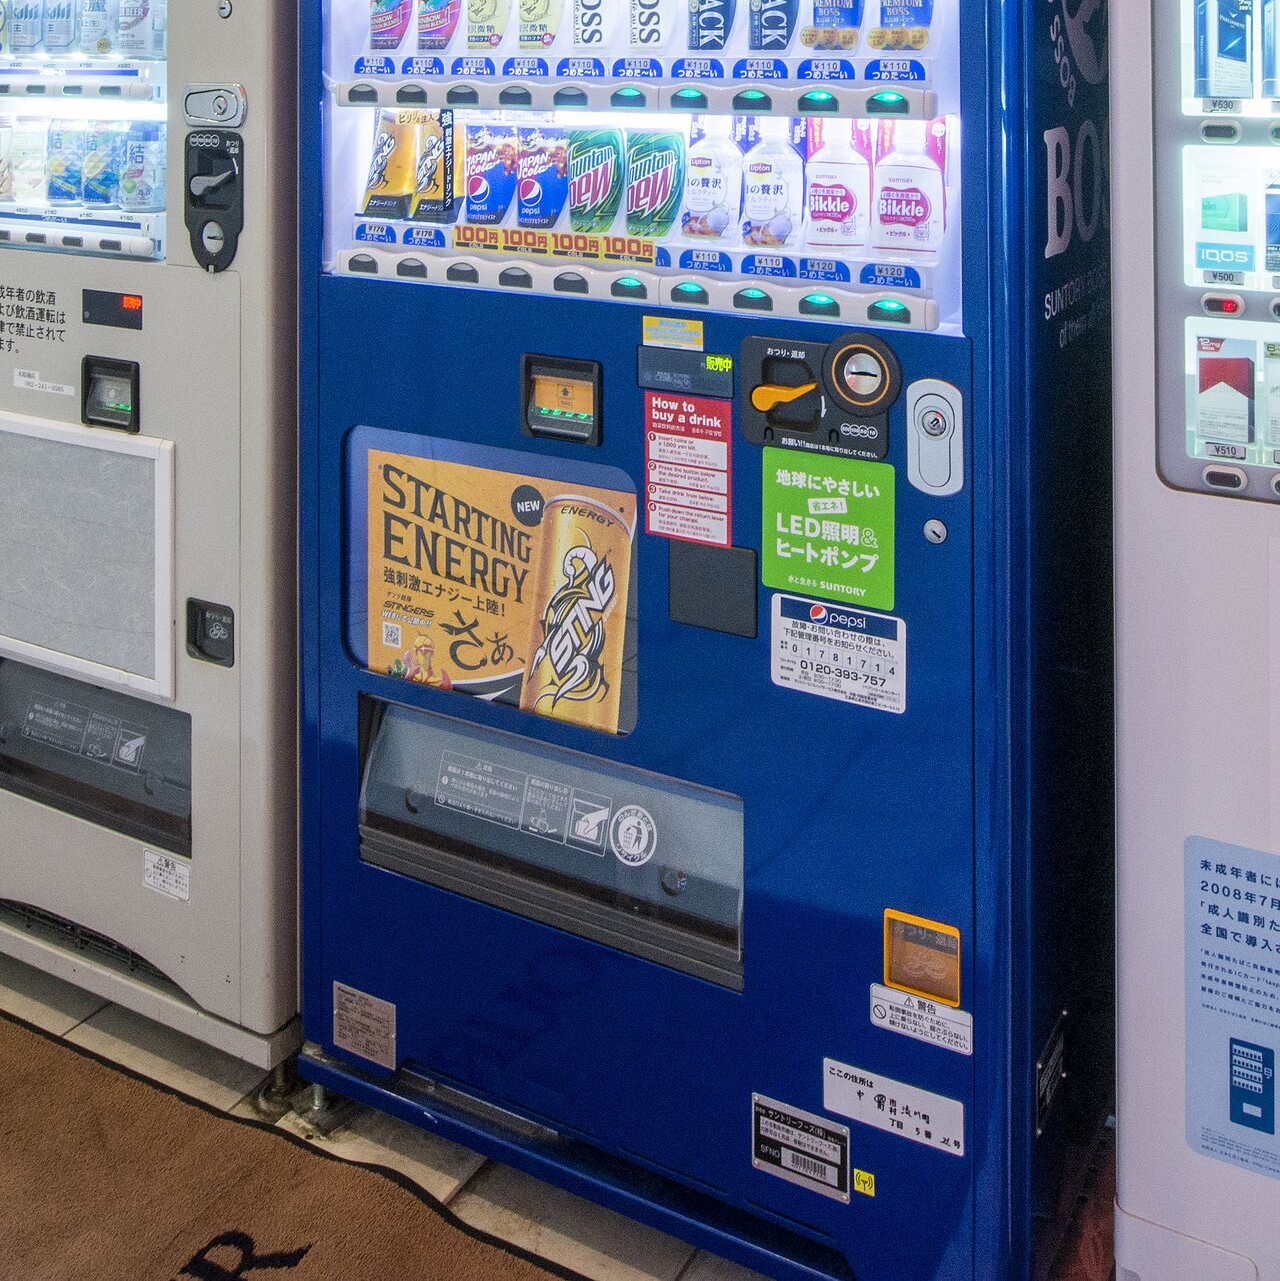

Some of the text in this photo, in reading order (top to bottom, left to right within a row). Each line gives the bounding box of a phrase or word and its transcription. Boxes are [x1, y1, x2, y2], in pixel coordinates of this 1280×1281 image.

[879, 198, 925, 218] Bikkle
[1200, 248, 1250, 265] IQOS
[706, 355, 733, 372] 販売中
[651, 396, 696, 413] How to
[651, 409, 722, 428] buy a drink
[1214, 444, 1238, 457] ¥510
[775, 468, 881, 499] 地球にやさしい
[382, 462, 532, 564] STARTING
[516, 500, 541, 514] NEW
[560, 505, 615, 528] ENERGY
[382, 510, 531, 605] ENERGY
[776, 537, 879, 573] ヒートポンプ
[383, 565, 507, 618] 強刺激エナジー上陸!
[820, 581, 867, 597] SUNTORY
[829, 612, 867, 629] pepsi
[800, 660, 886, 687] 0120-393-757
[916, 999, 937, 1016] 警告
[827, 1066, 874, 1089] ここの住所は
